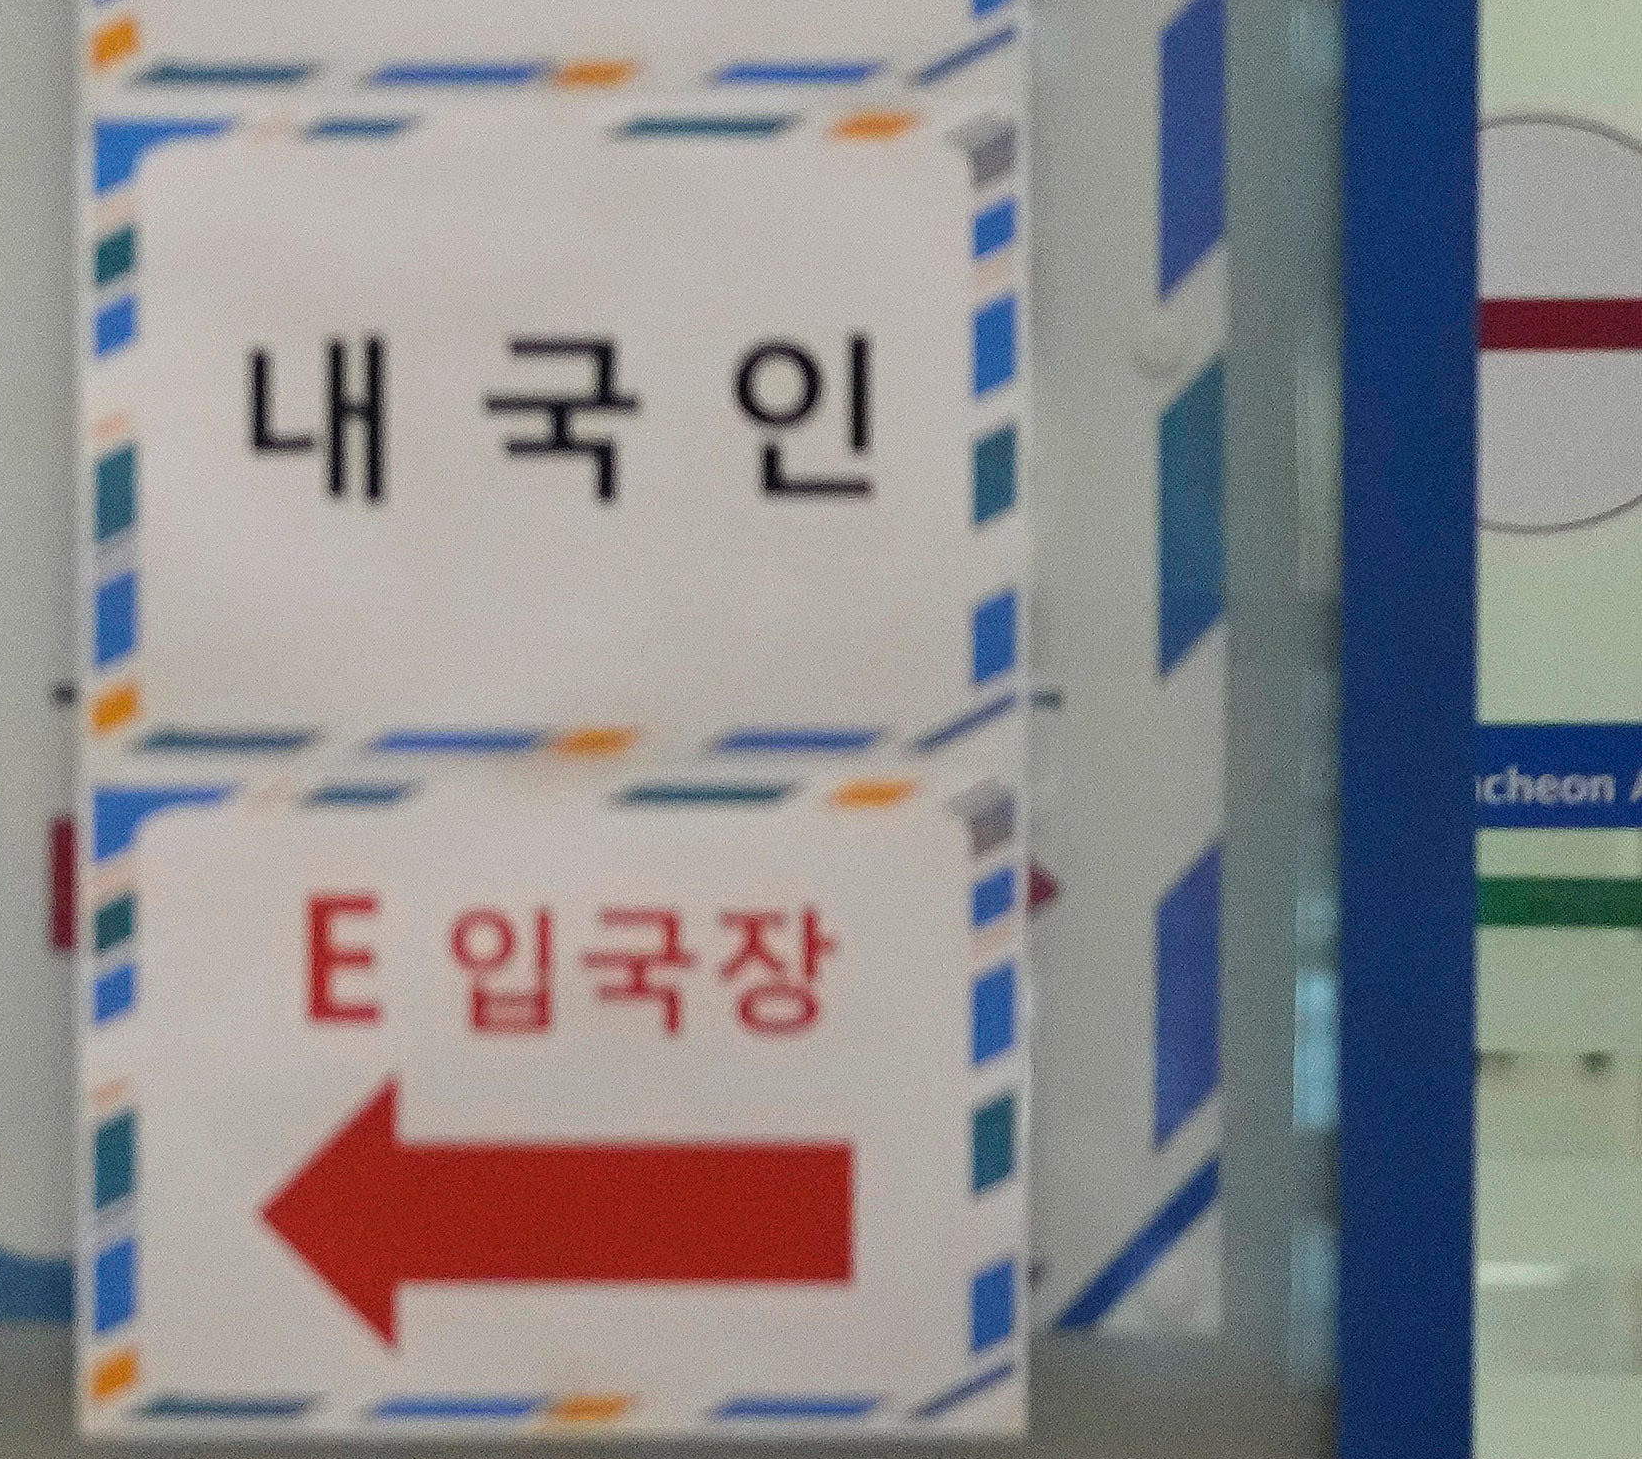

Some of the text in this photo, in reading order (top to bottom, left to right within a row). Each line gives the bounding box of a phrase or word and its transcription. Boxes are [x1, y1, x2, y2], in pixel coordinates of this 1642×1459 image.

[1475, 763, 1616, 805] cheon
[306, 894, 837, 1037] E 입국장
